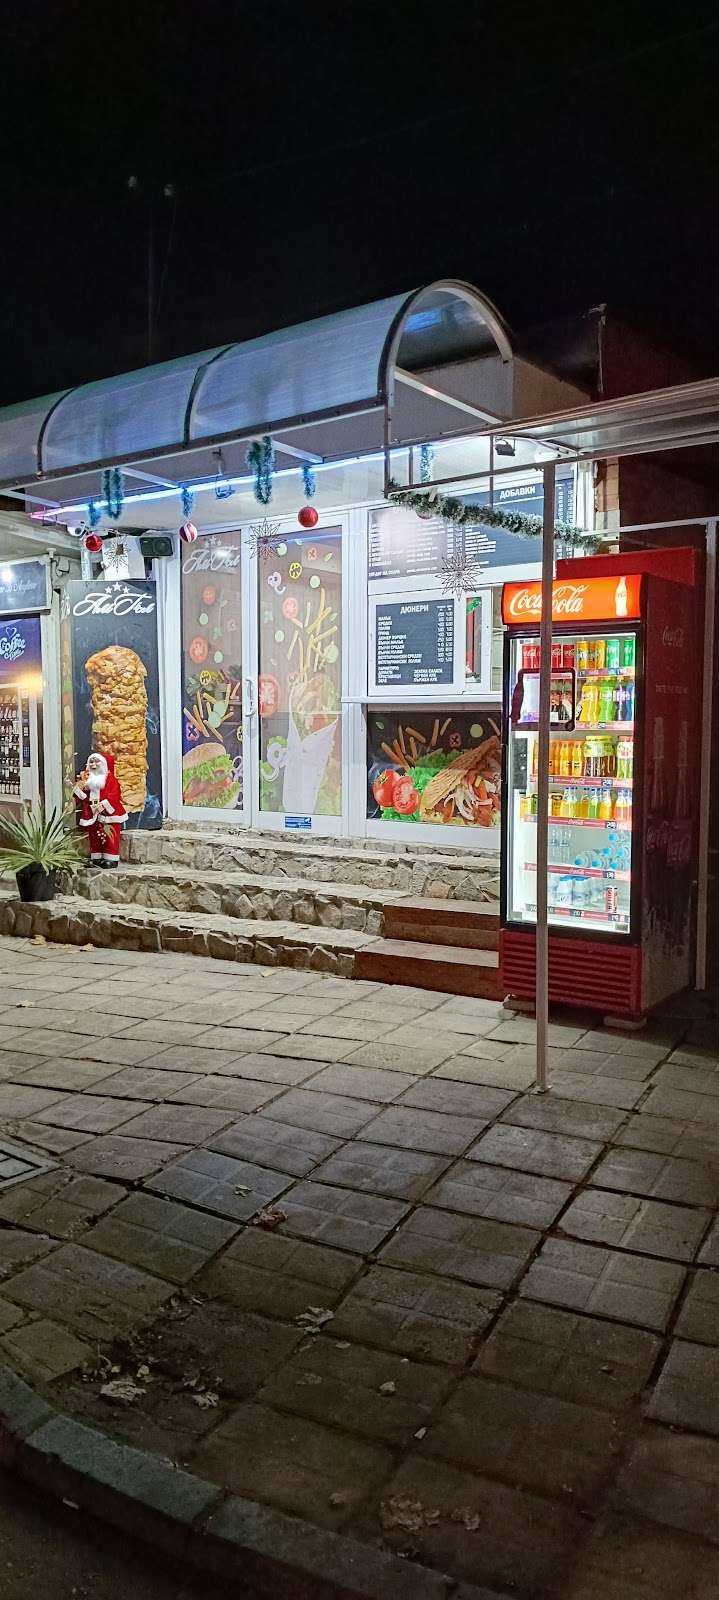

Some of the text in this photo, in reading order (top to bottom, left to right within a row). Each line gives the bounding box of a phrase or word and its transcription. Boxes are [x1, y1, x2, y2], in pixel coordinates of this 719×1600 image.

[500, 486, 535, 500] ДОБАВКИ
[509, 585, 590, 616] Cocaola
[400, 604, 429, 615] ДЮНЕРИ
